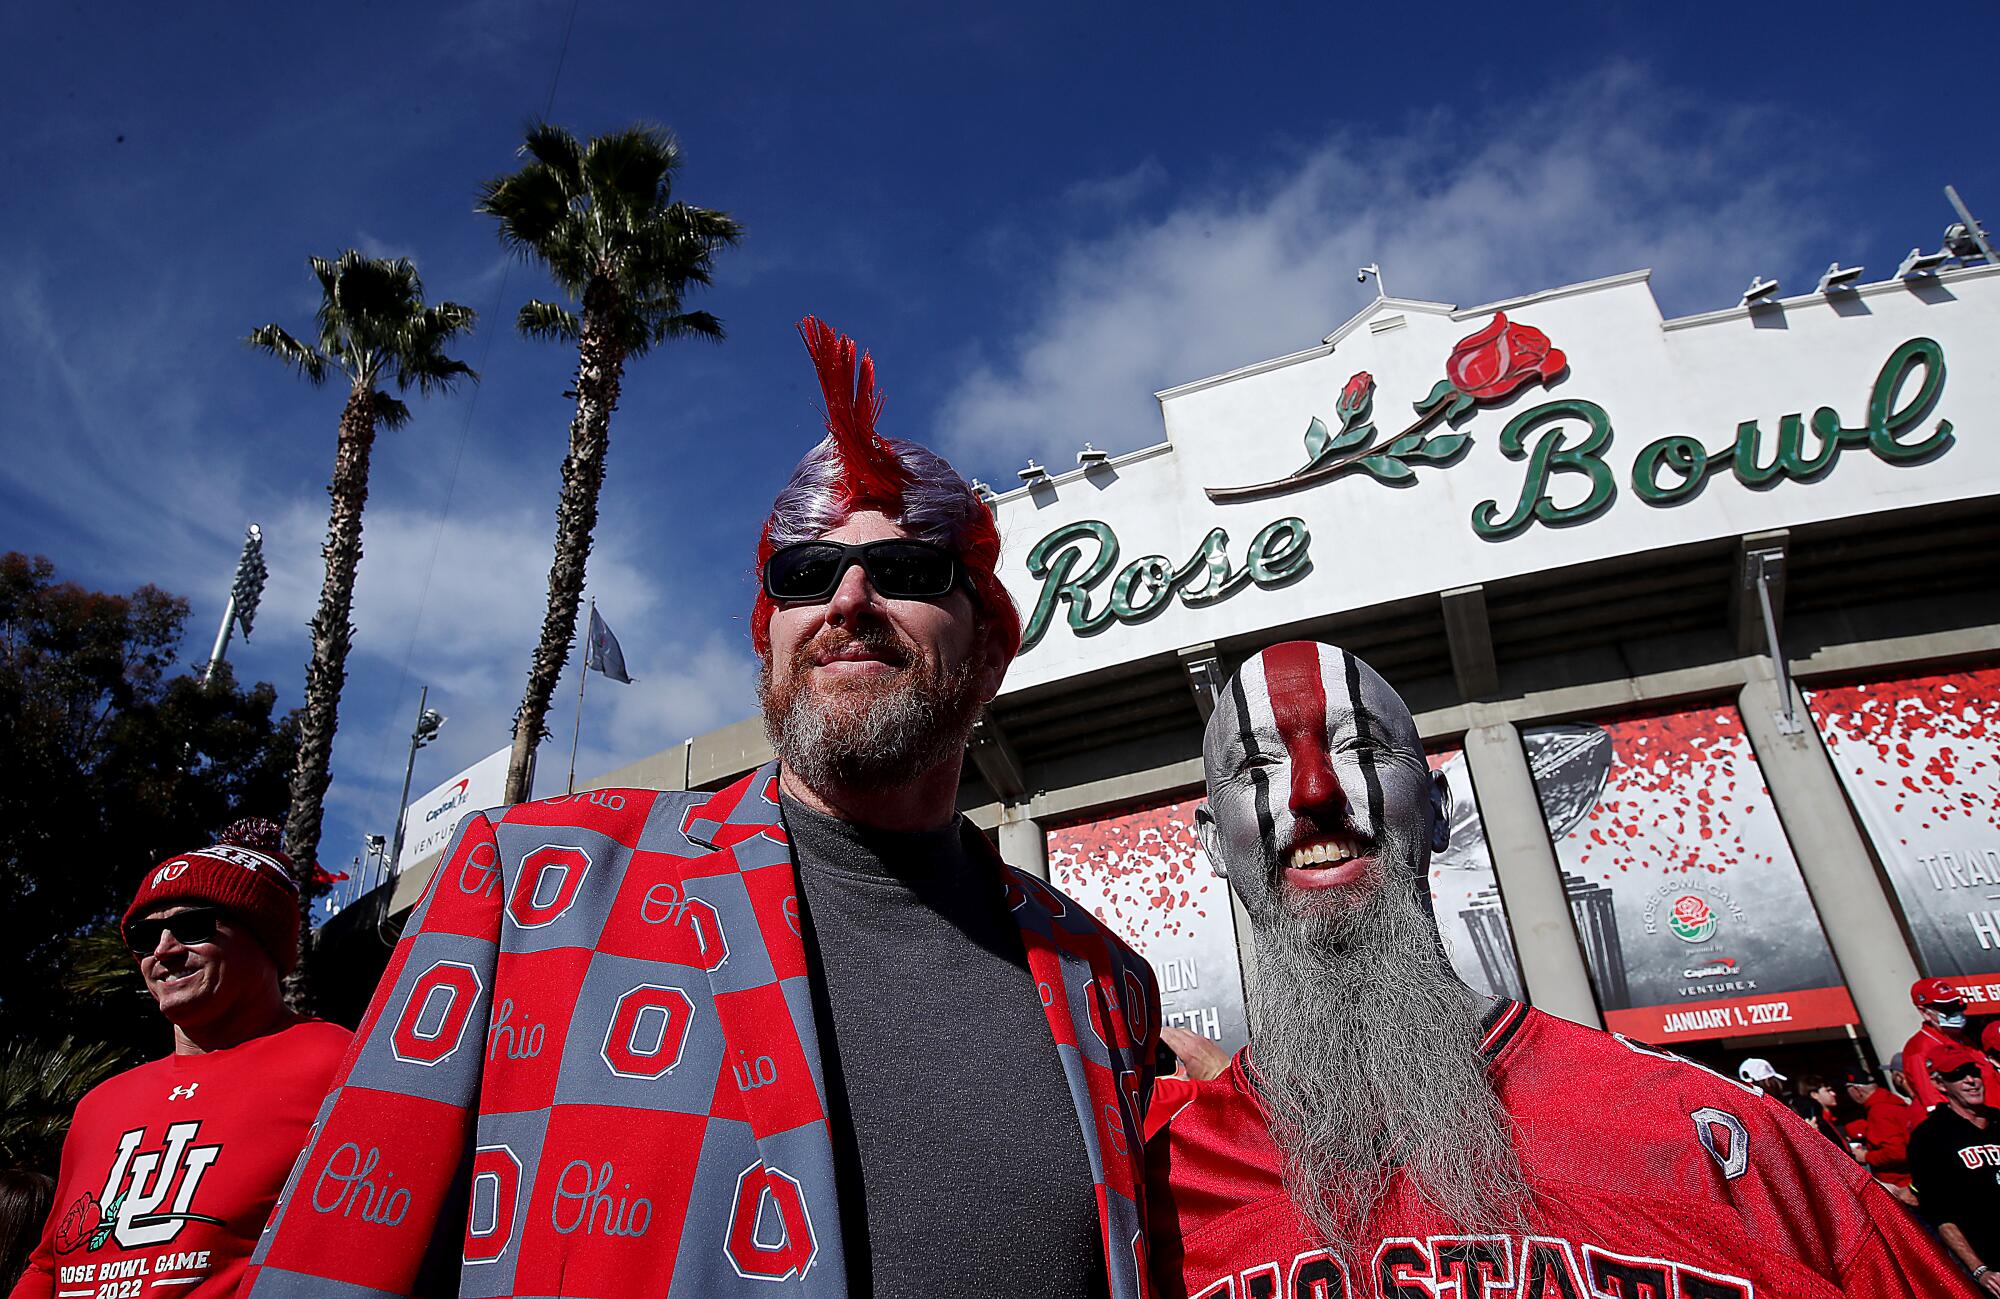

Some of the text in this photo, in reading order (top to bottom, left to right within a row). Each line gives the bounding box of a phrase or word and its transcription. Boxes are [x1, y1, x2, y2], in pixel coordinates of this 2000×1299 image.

[1018, 337, 1956, 657] Rose Bowl
[390, 960, 483, 1067] O
[1663, 1001, 1793, 1034] JANUARY 1, 2022
[1678, 980, 1758, 997] VENTURE X
[600, 983, 696, 1081] O
[312, 1141, 412, 1228] Ohio
[551, 1158, 653, 1238] Ohio
[60, 1264, 97, 1284] ROSE
[98, 1258, 150, 1280] BOWL
